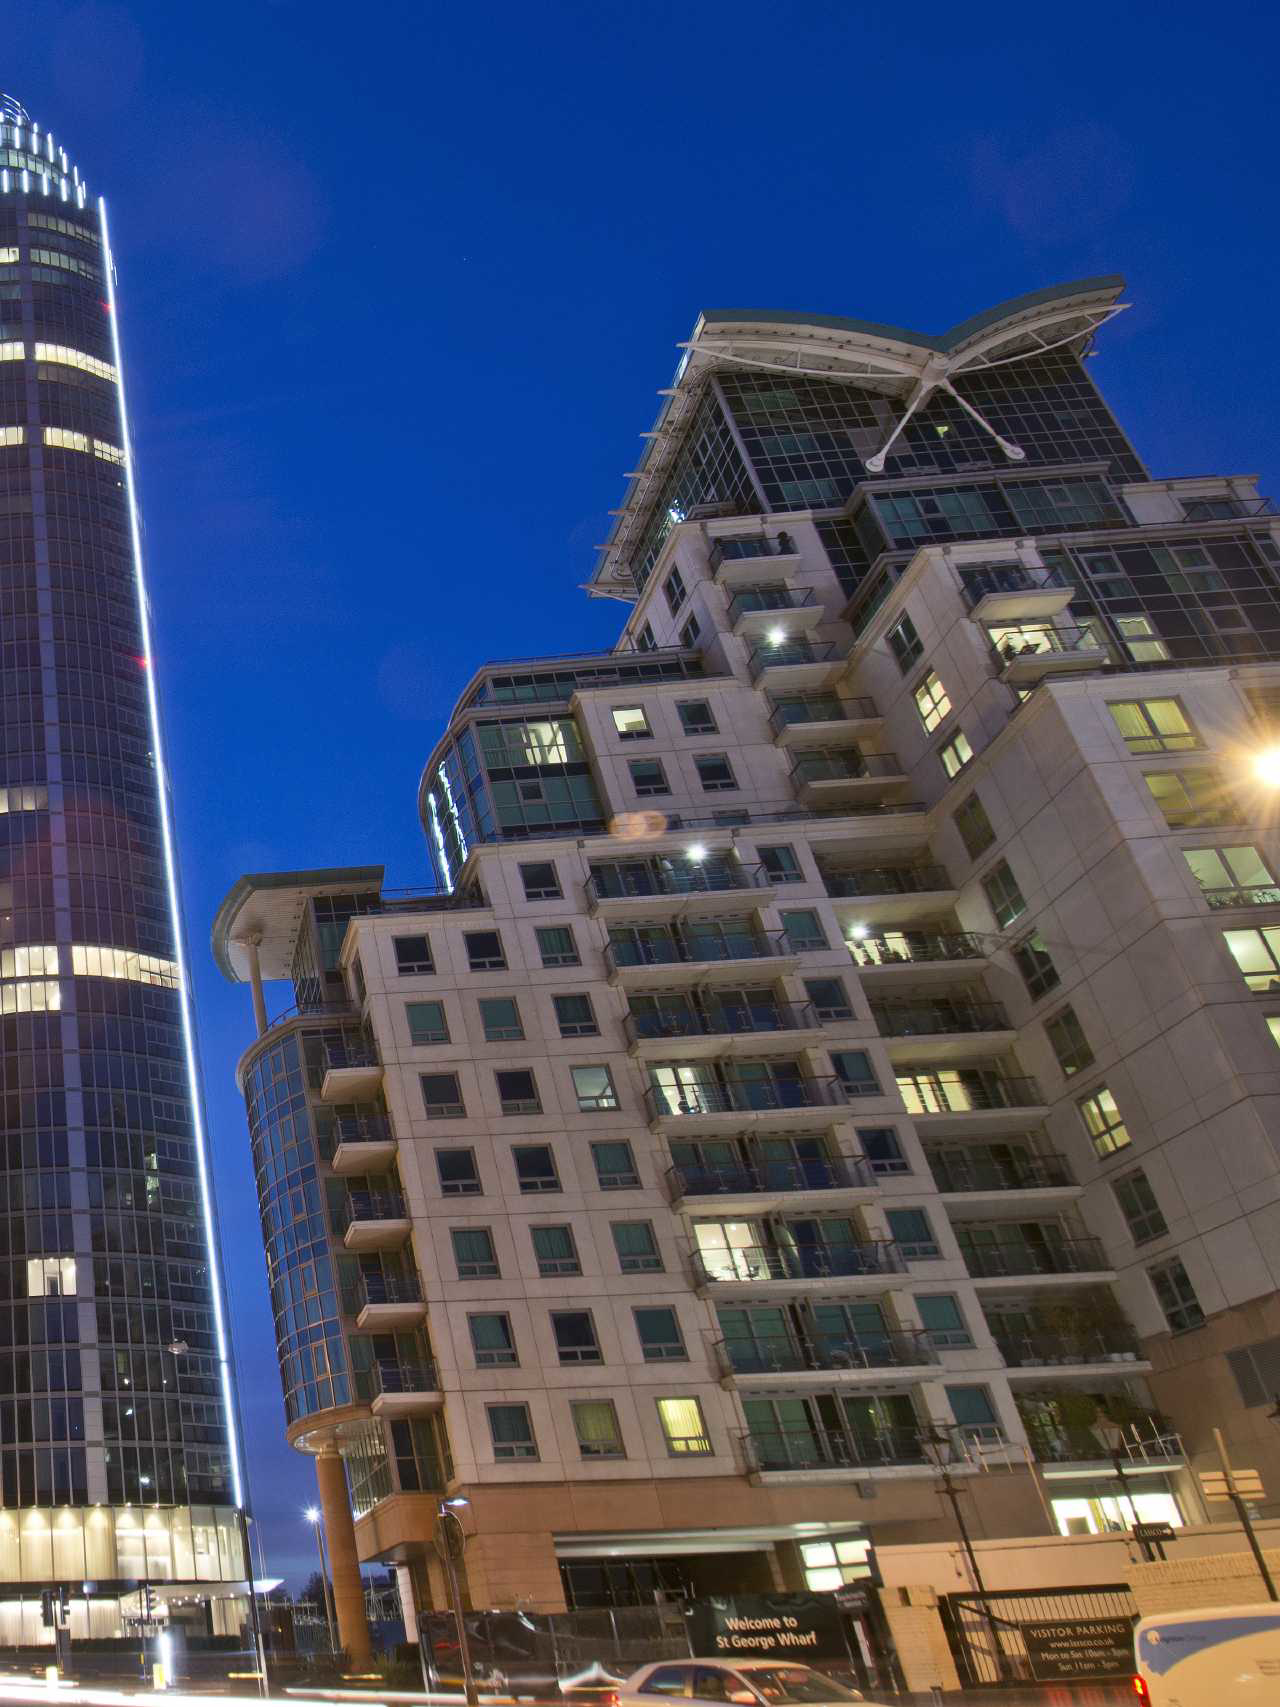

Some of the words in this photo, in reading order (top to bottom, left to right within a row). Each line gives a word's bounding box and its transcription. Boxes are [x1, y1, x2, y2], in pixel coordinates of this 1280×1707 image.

[724, 1616, 781, 1631] Welcome
[783, 1616, 798, 1628] to
[1031, 1627, 1073, 1638] VISITOR
[1076, 1624, 1125, 1635] PARKING
[716, 1635, 730, 1648] St
[730, 1633, 776, 1649] George
[776, 1630, 817, 1646] Wharf
[1040, 1652, 1059, 1661] Mon
[1058, 1662, 1073, 1672] Sun
